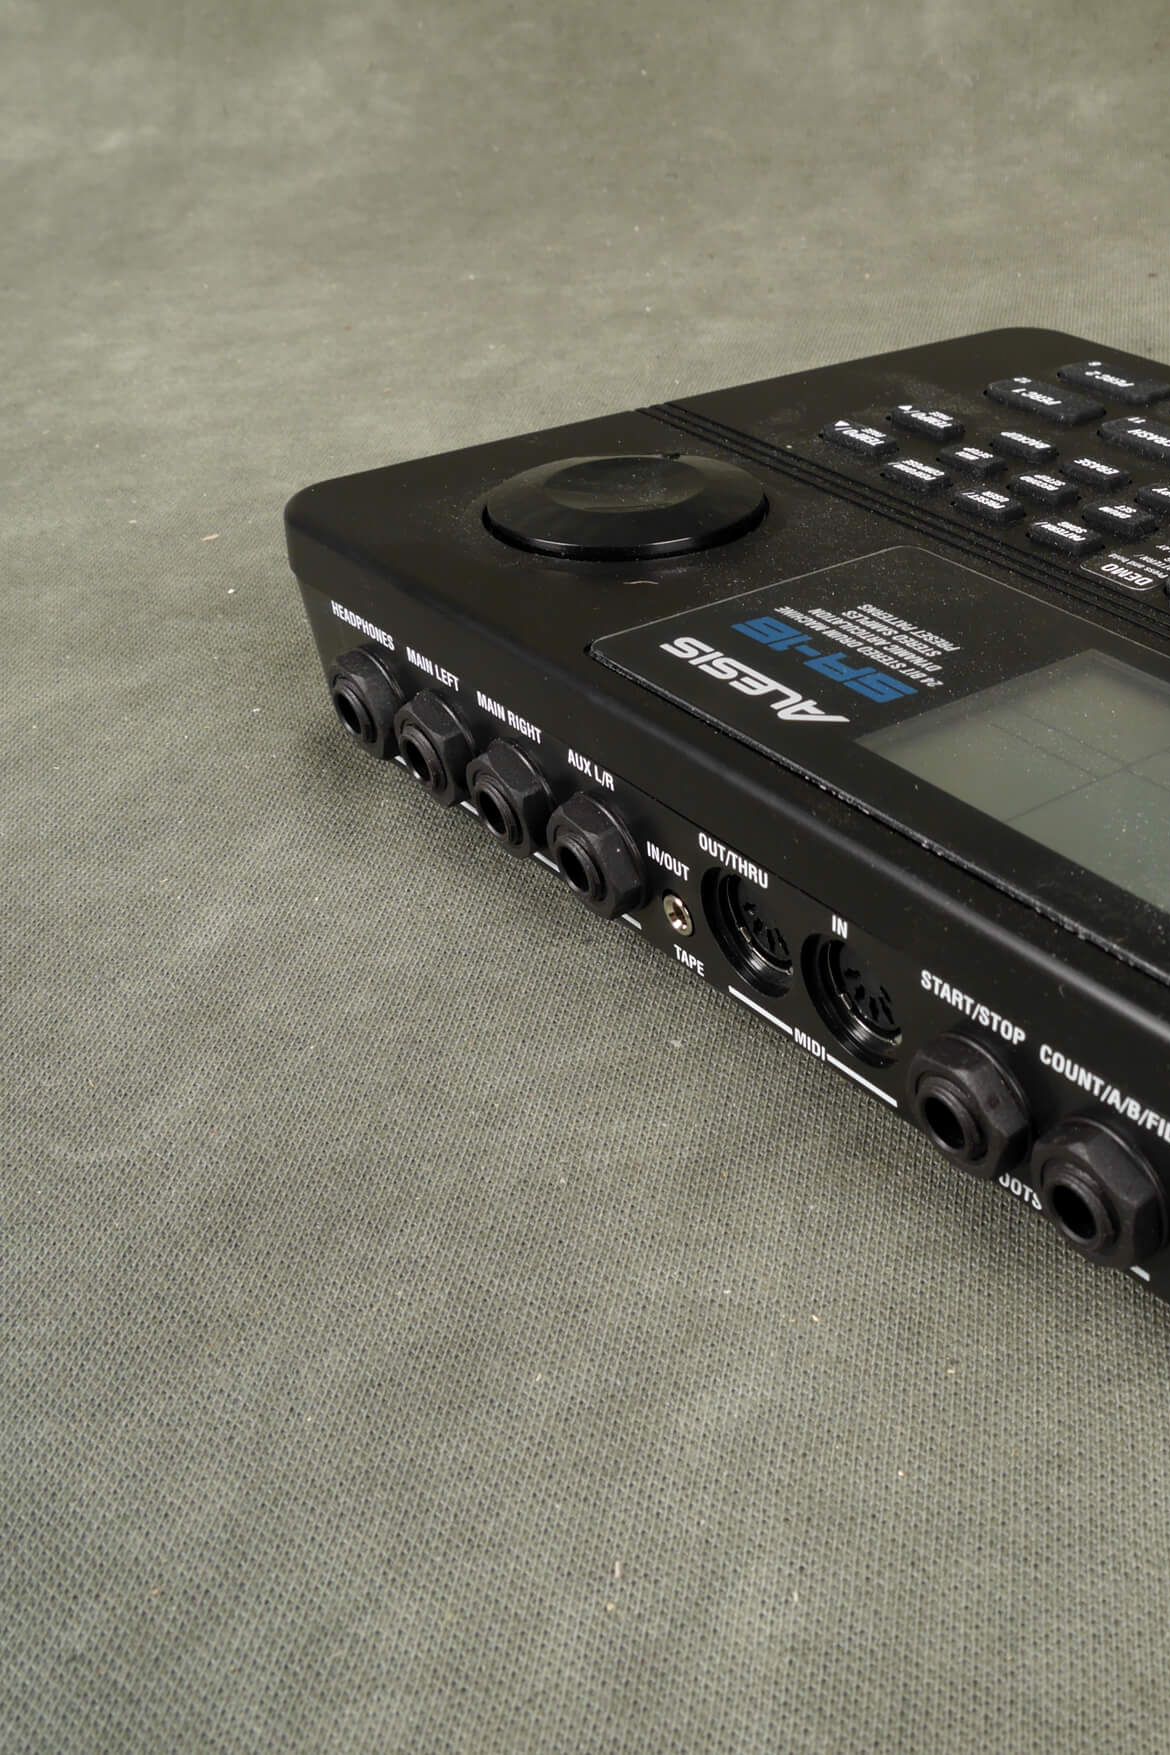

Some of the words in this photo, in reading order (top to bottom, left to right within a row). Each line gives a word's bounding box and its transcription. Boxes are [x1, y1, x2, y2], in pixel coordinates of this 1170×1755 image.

[1084, 369, 1102, 377] 2
[1094, 372, 1135, 388] PERC
[1020, 390, 1063, 406] PERC
[1126, 416, 1147, 425] 11
[1073, 457, 1120, 476] ERASE
[1107, 552, 1131, 564] hold
[1122, 559, 1146, 570] and
[1100, 562, 1154, 587] DEMO
[1142, 566, 1169, 580] Press
[331, 600, 395, 652] HEADPHONES
[774, 606, 830, 631] MACHINE
[808, 608, 891, 646] ARTICULATION
[841, 610, 899, 636] SAMPLES
[857, 604, 918, 631] PATTERNS
[821, 628, 865, 649] DRUM
[891, 633, 943, 658] STEREO
[908, 629, 961, 653] PRESET
[406, 646, 433, 677] MAIN
[435, 661, 460, 692] LEFT
[732, 616, 917, 703] SR-16
[856, 645, 908, 670] STEREO
[883, 643, 942, 672] DYNAMIC
[659, 637, 850, 722] ALESIS
[897, 667, 928, 680] BIT
[919, 676, 944, 688] 24
[477, 691, 505, 722] MAIN
[507, 709, 542, 744] RIGHT
[567, 749, 592, 778] AUX
[593, 766, 615, 792] L/R
[646, 841, 690, 882] IN/OUT
[699, 833, 769, 889] OUT/THRU
[831, 914, 848, 940] IN
[674, 943, 705, 977] TAPE
[920, 969, 1026, 1046] START/STOP
[794, 1027, 827, 1061] MIDI
